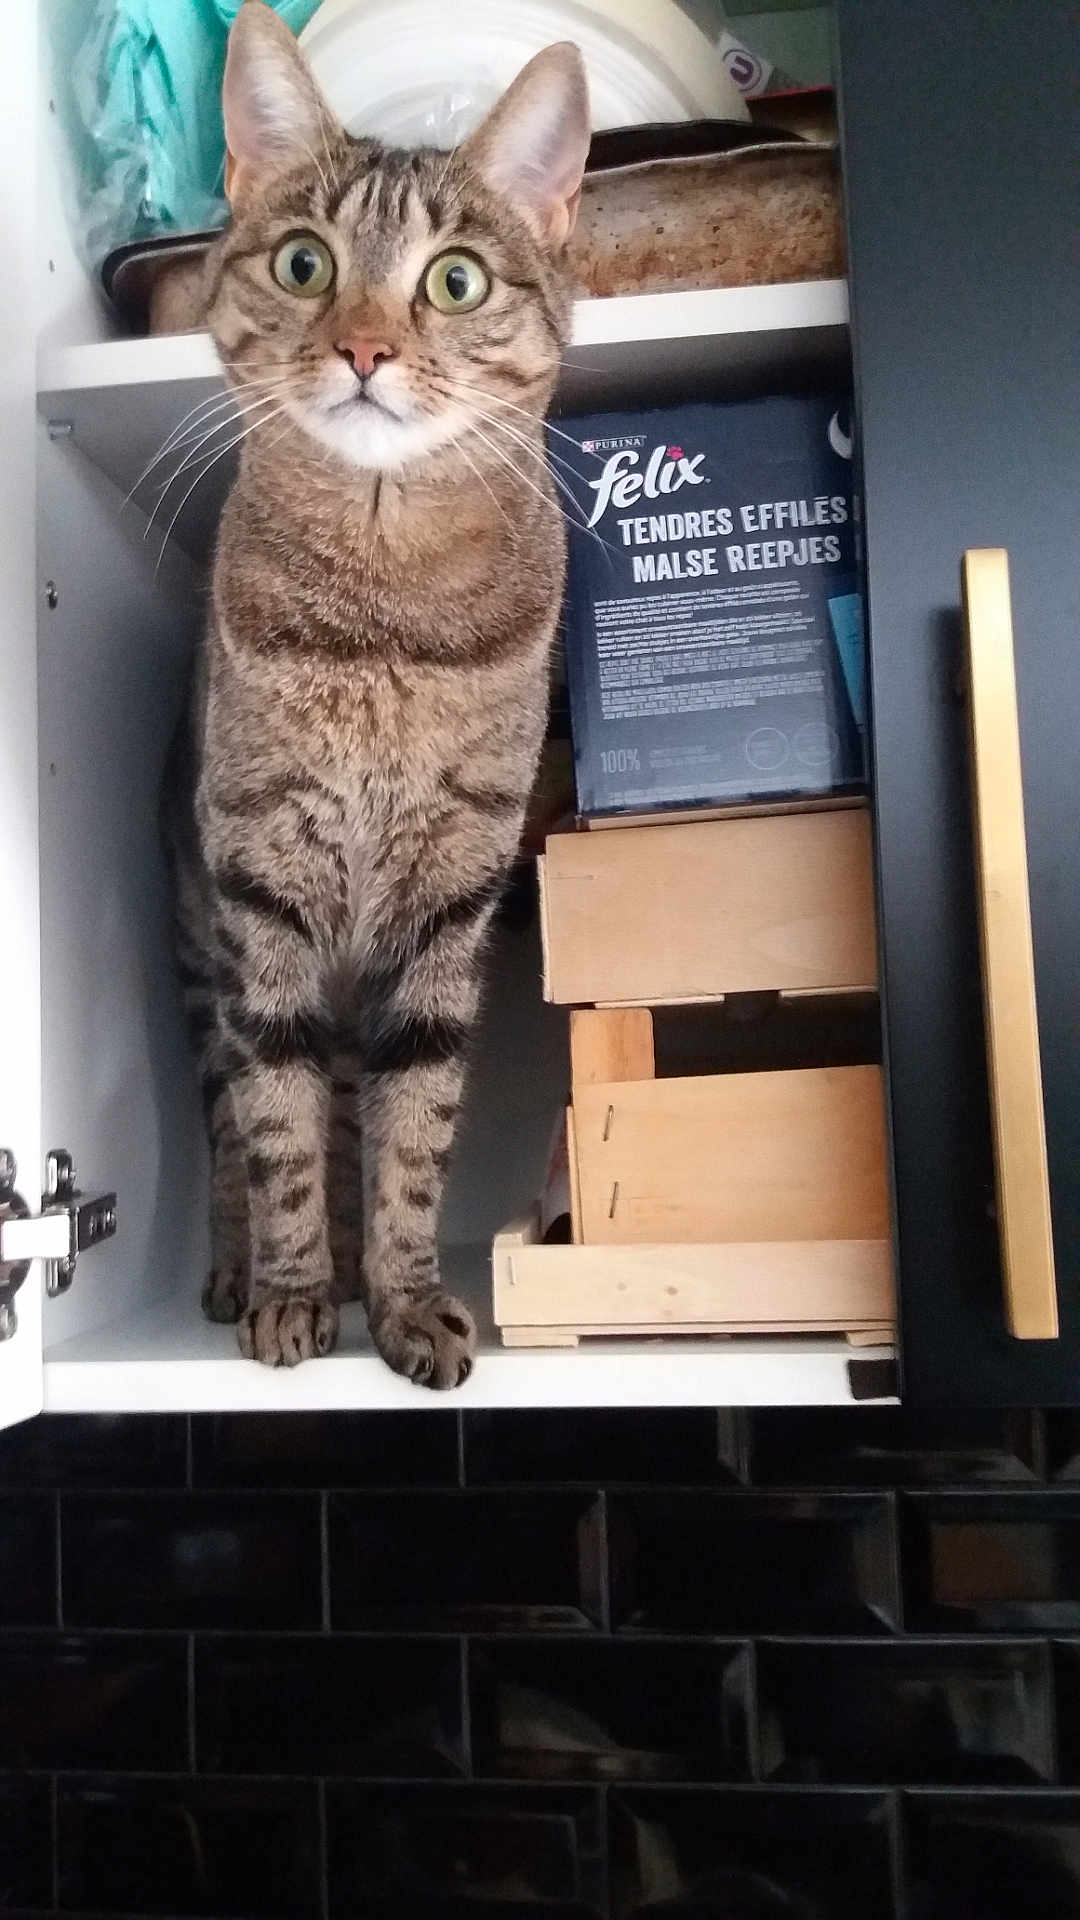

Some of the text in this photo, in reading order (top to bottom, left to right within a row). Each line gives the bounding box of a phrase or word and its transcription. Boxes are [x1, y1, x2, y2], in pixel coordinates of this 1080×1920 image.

[595, 438, 641, 449] PURINA
[617, 508, 734, 546] TENDRES
[632, 535, 842, 583] MALSE REEPJES
[600, 748, 640, 773] 100%
